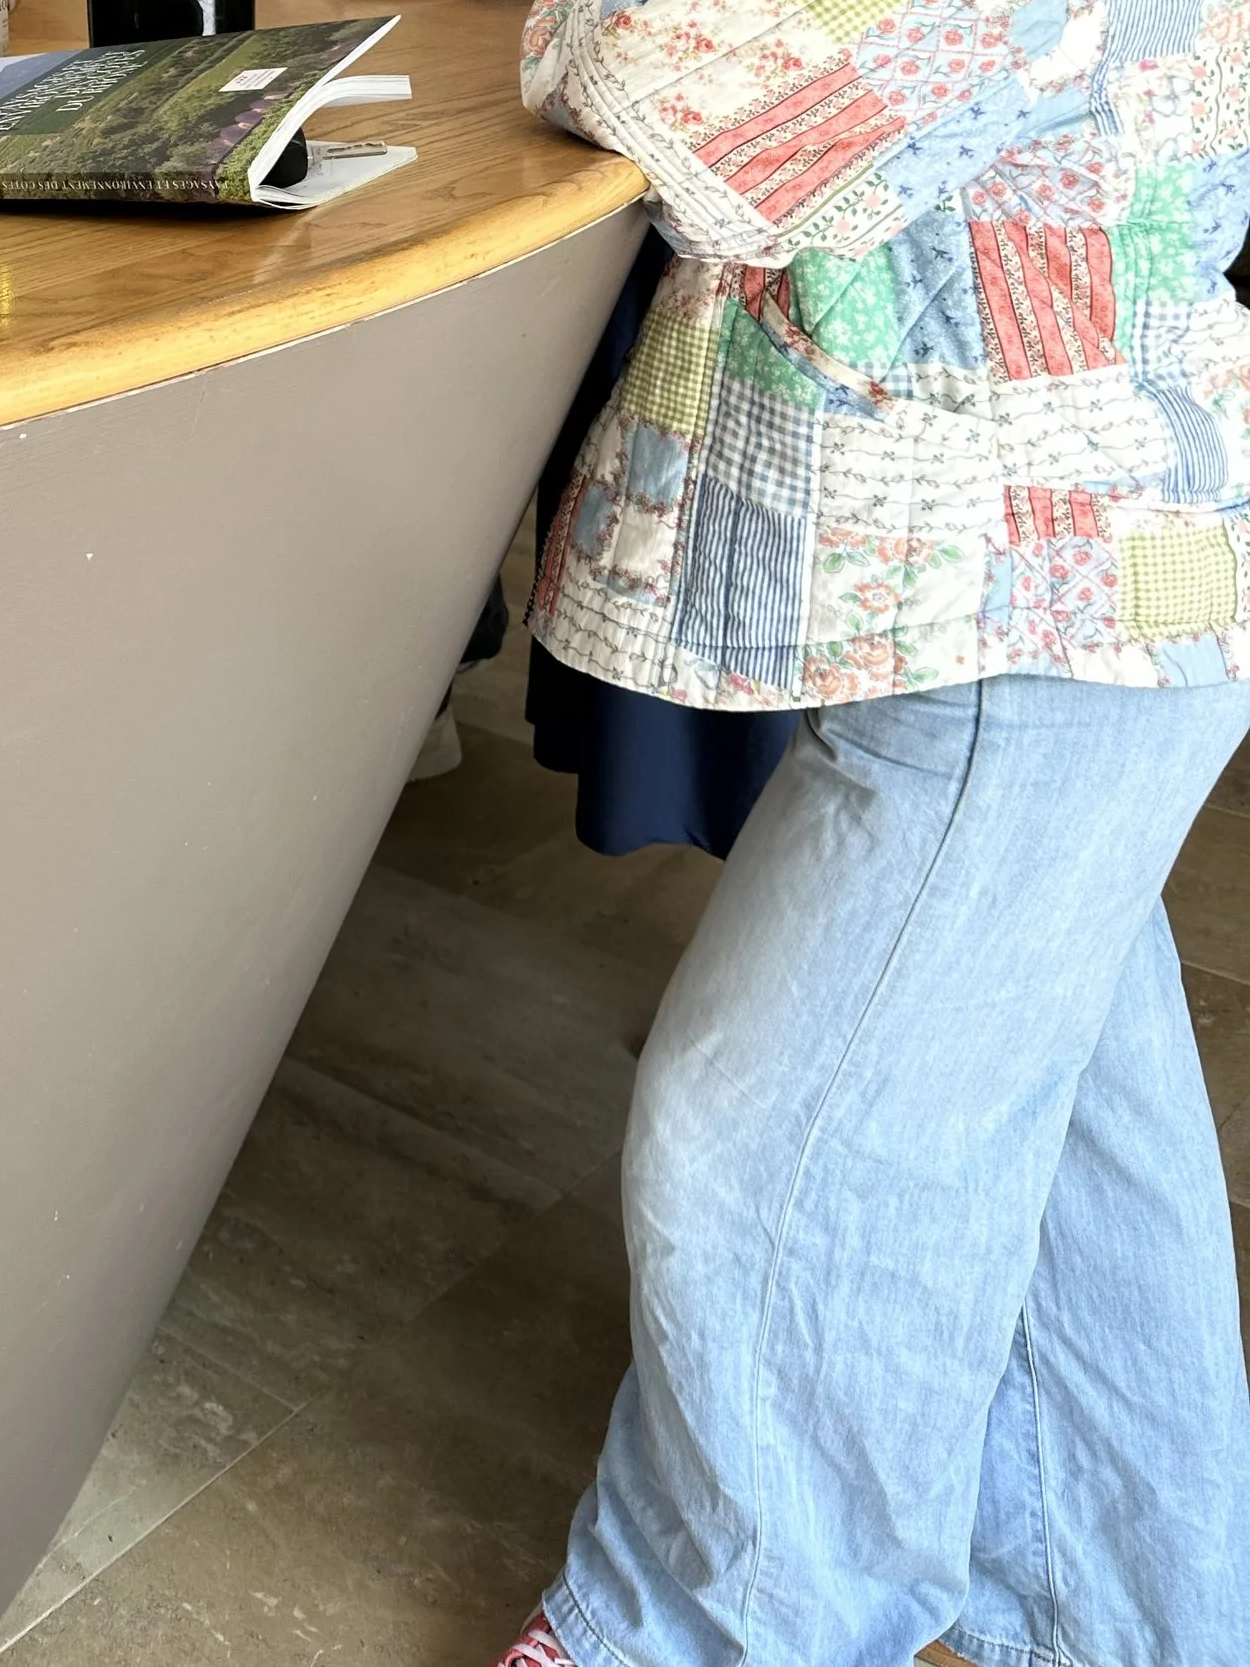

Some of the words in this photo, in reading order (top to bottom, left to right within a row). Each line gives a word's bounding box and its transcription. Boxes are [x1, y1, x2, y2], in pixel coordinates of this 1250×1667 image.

[38, 180, 59, 190] DES
[62, 180, 153, 190] ENVIRONNEMENT
[156, 180, 170, 190] ET
[172, 180, 229, 191] PAYSAGES
